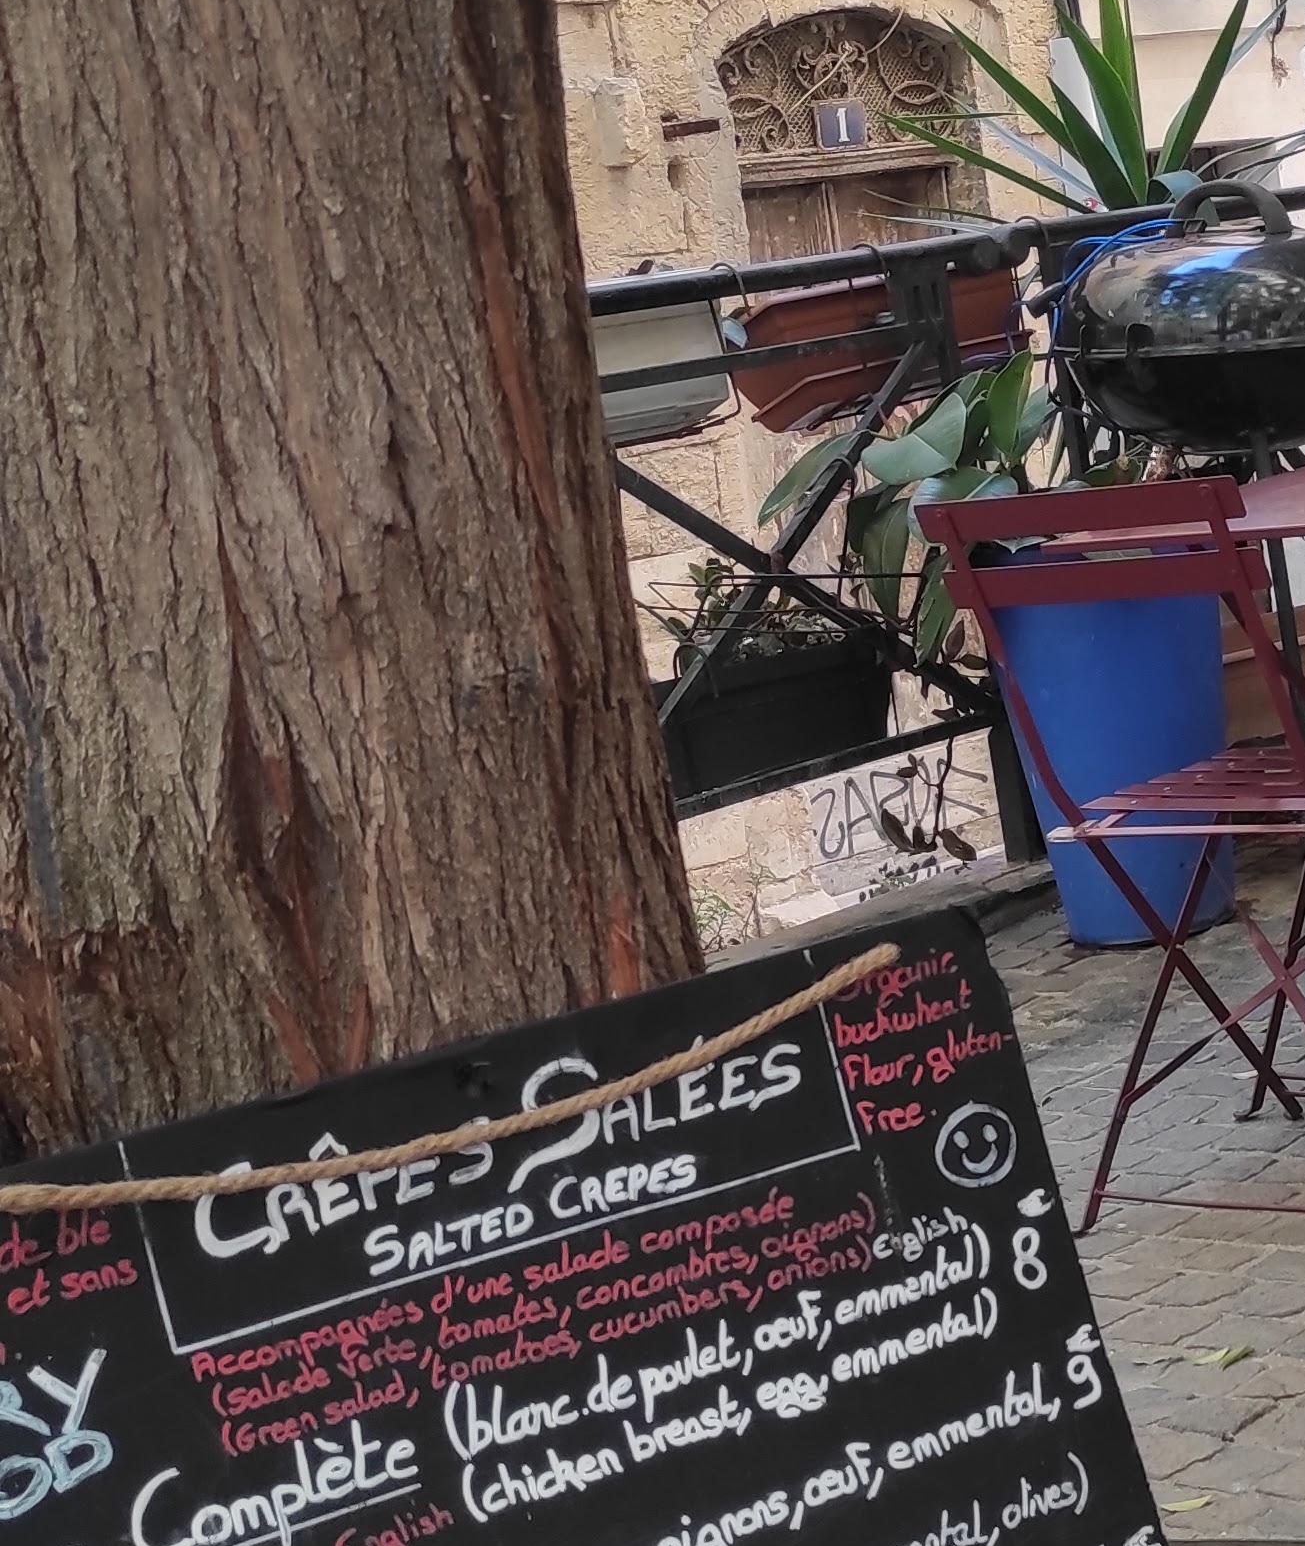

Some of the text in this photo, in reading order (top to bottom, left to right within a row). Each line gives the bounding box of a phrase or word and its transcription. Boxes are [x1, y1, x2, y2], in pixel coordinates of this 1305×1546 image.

[836, 107, 850, 143] 1
[364, 1154, 696, 1275] SALTED CREPES
[6, 1259, 137, 1314] et sans
[190, 1188, 793, 1381] Accompagnées d'une salade composée
[638, 1319, 753, 1423] poulet,
[835, 1223, 990, 1324] emmental)
[211, 1351, 331, 1417] (salade
[462, 1448, 623, 1522] (chicken
[623, 1385, 751, 1462] breast,
[821, 1287, 997, 1381] emmental)
[887, 1362, 1060, 1469] emmental,
[1002, 1452, 1088, 1528] olives)
